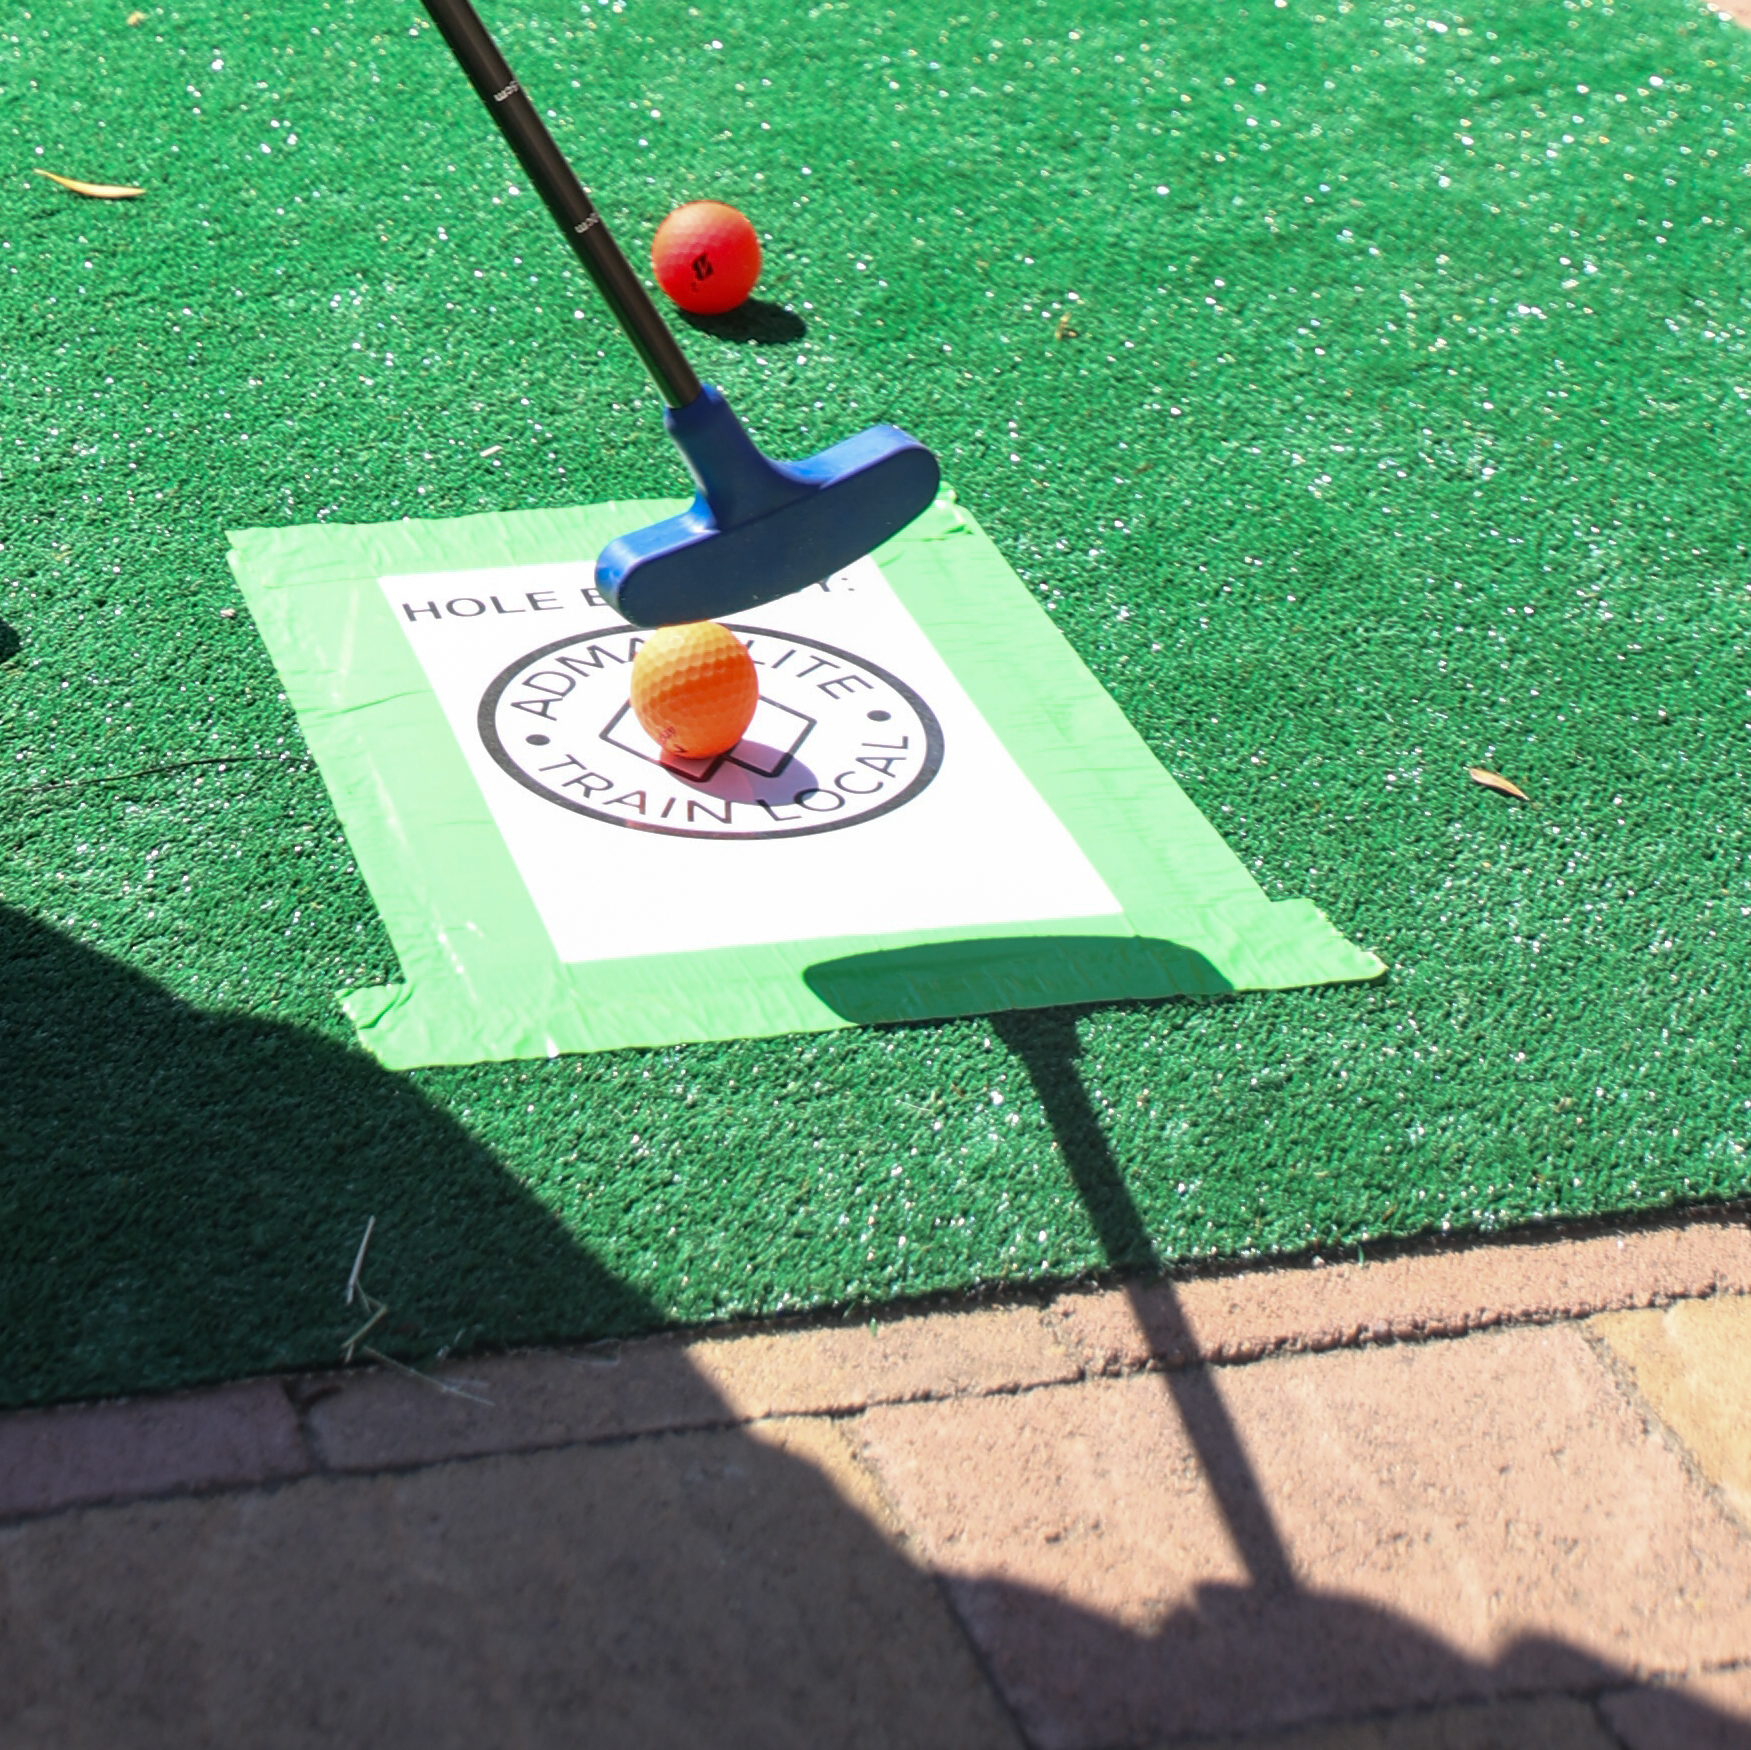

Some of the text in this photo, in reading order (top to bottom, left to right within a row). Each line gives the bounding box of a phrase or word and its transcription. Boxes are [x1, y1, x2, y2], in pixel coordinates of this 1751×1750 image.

[402, 590, 565, 622] HOLE
[538, 736, 909, 825] TRAIN LOCAL
